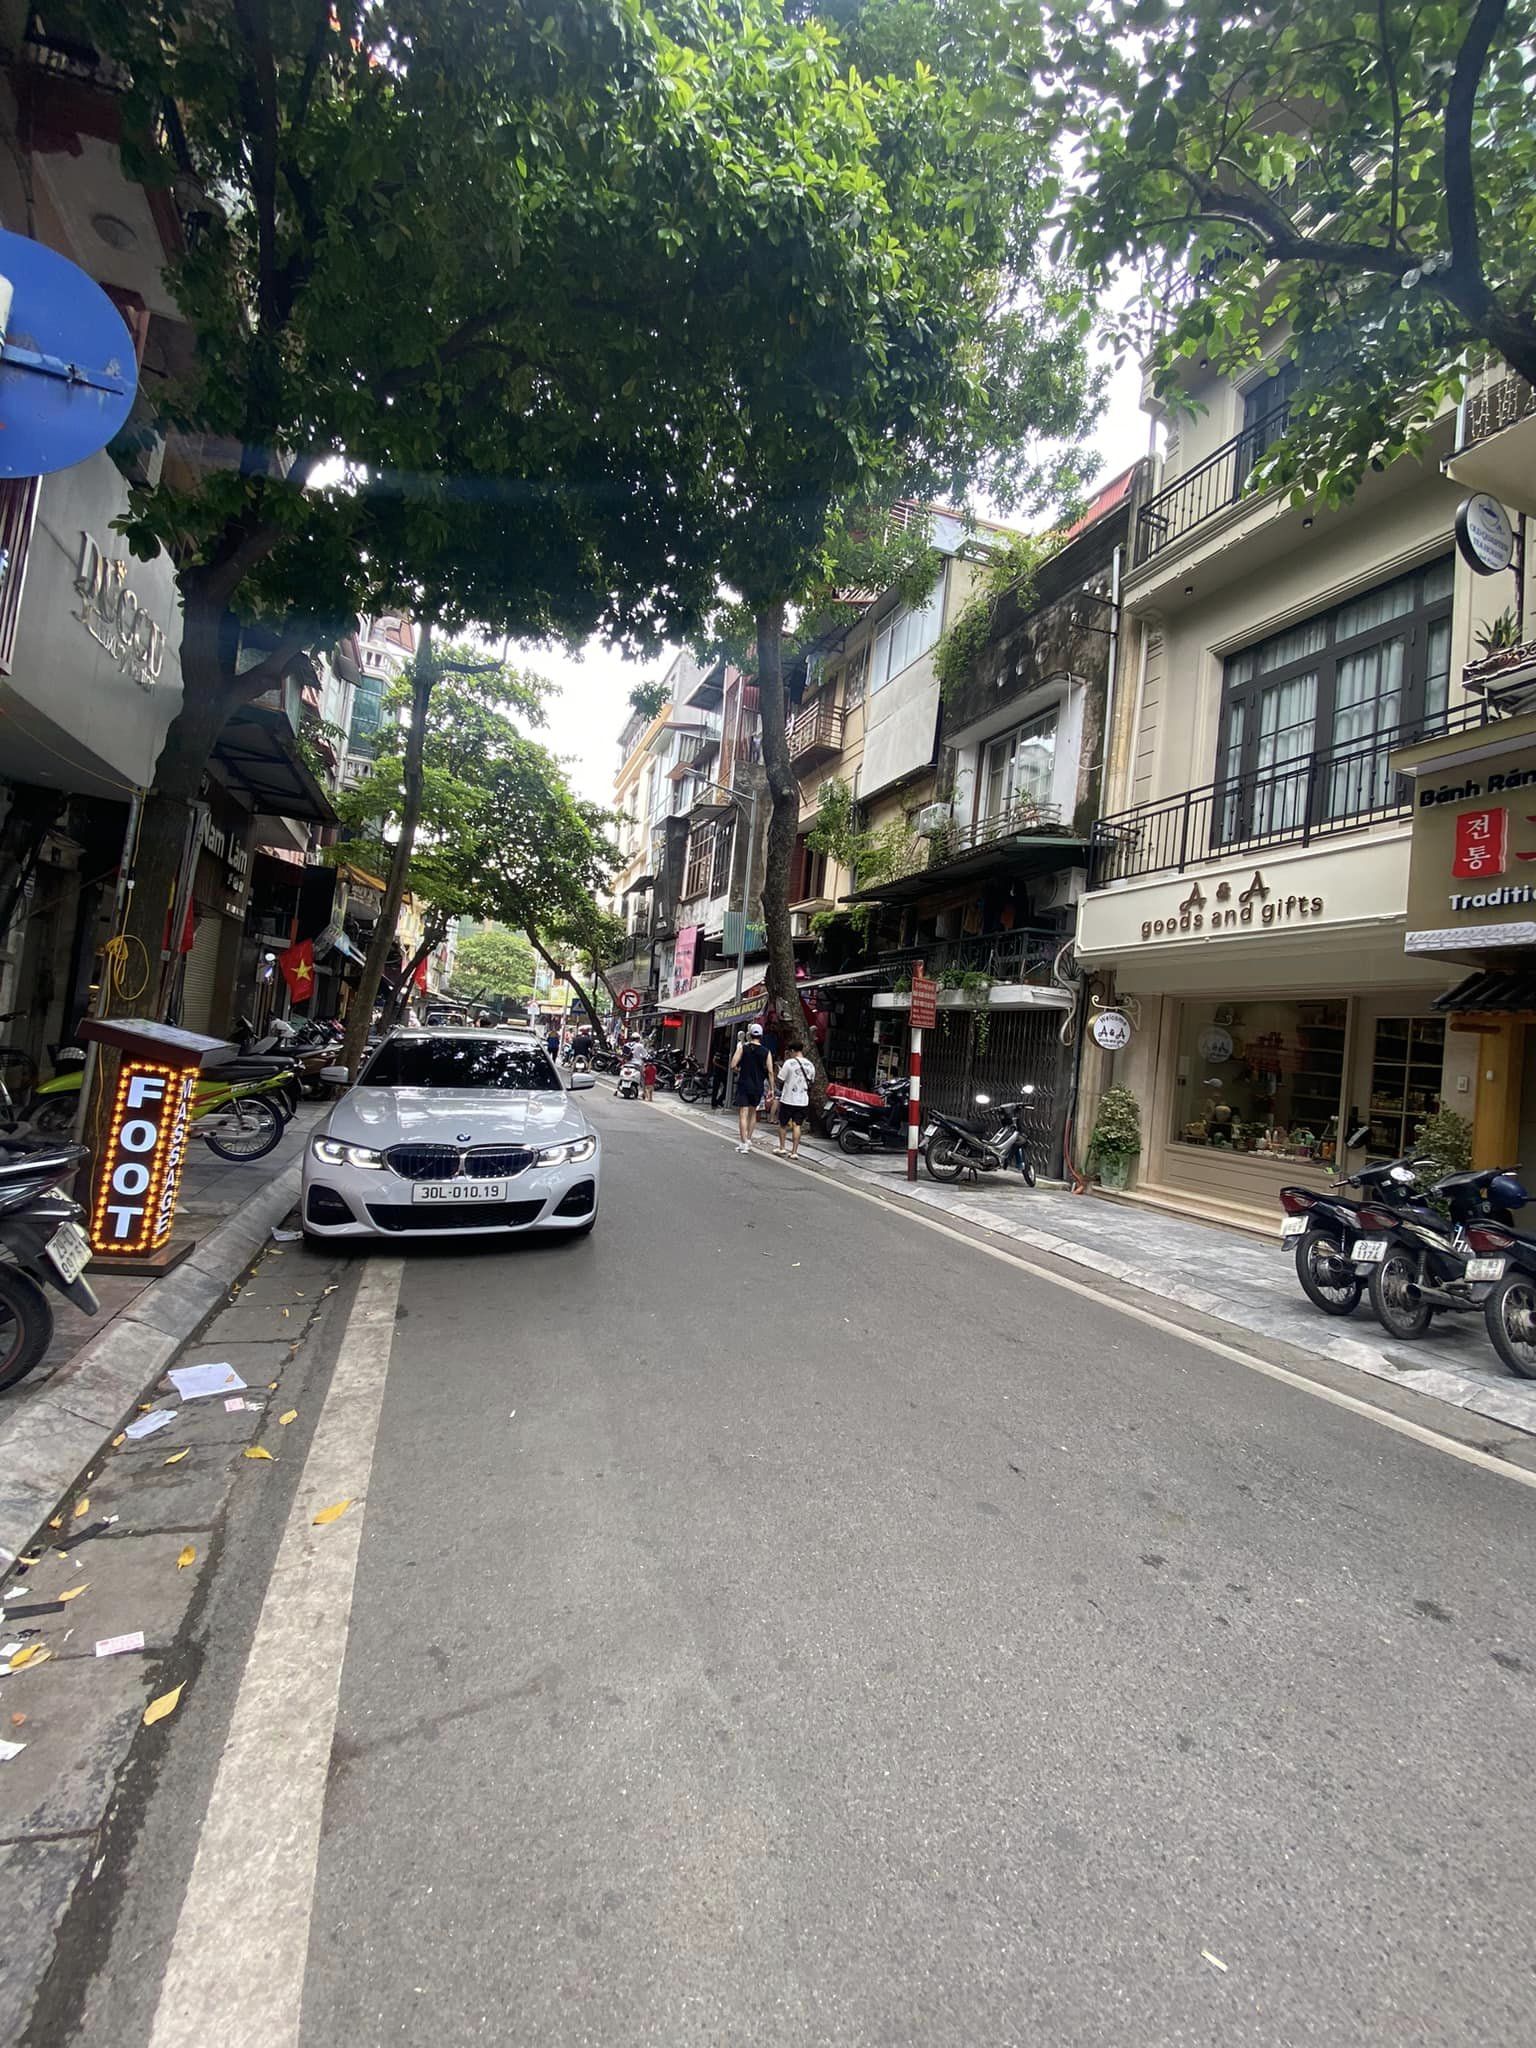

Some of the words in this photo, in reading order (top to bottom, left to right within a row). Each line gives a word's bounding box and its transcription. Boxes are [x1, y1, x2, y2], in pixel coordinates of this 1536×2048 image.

[1420, 779, 1482, 807] Bánh
[1462, 815, 1491, 870] 전통
[1180, 882, 1207, 912] A
[1239, 870, 1271, 903] A
[1141, 911, 1204, 941] goods
[1211, 902, 1254, 928] and
[1262, 895, 1323, 926] gifts
[1098, 1025, 1108, 1037] A
[1115, 1028, 1125, 1040] A
[107, 1076, 166, 1238] FOOT
[156, 1079, 193, 1235] MASSAGE
[421, 1185, 499, 1199] 30L-010.19
